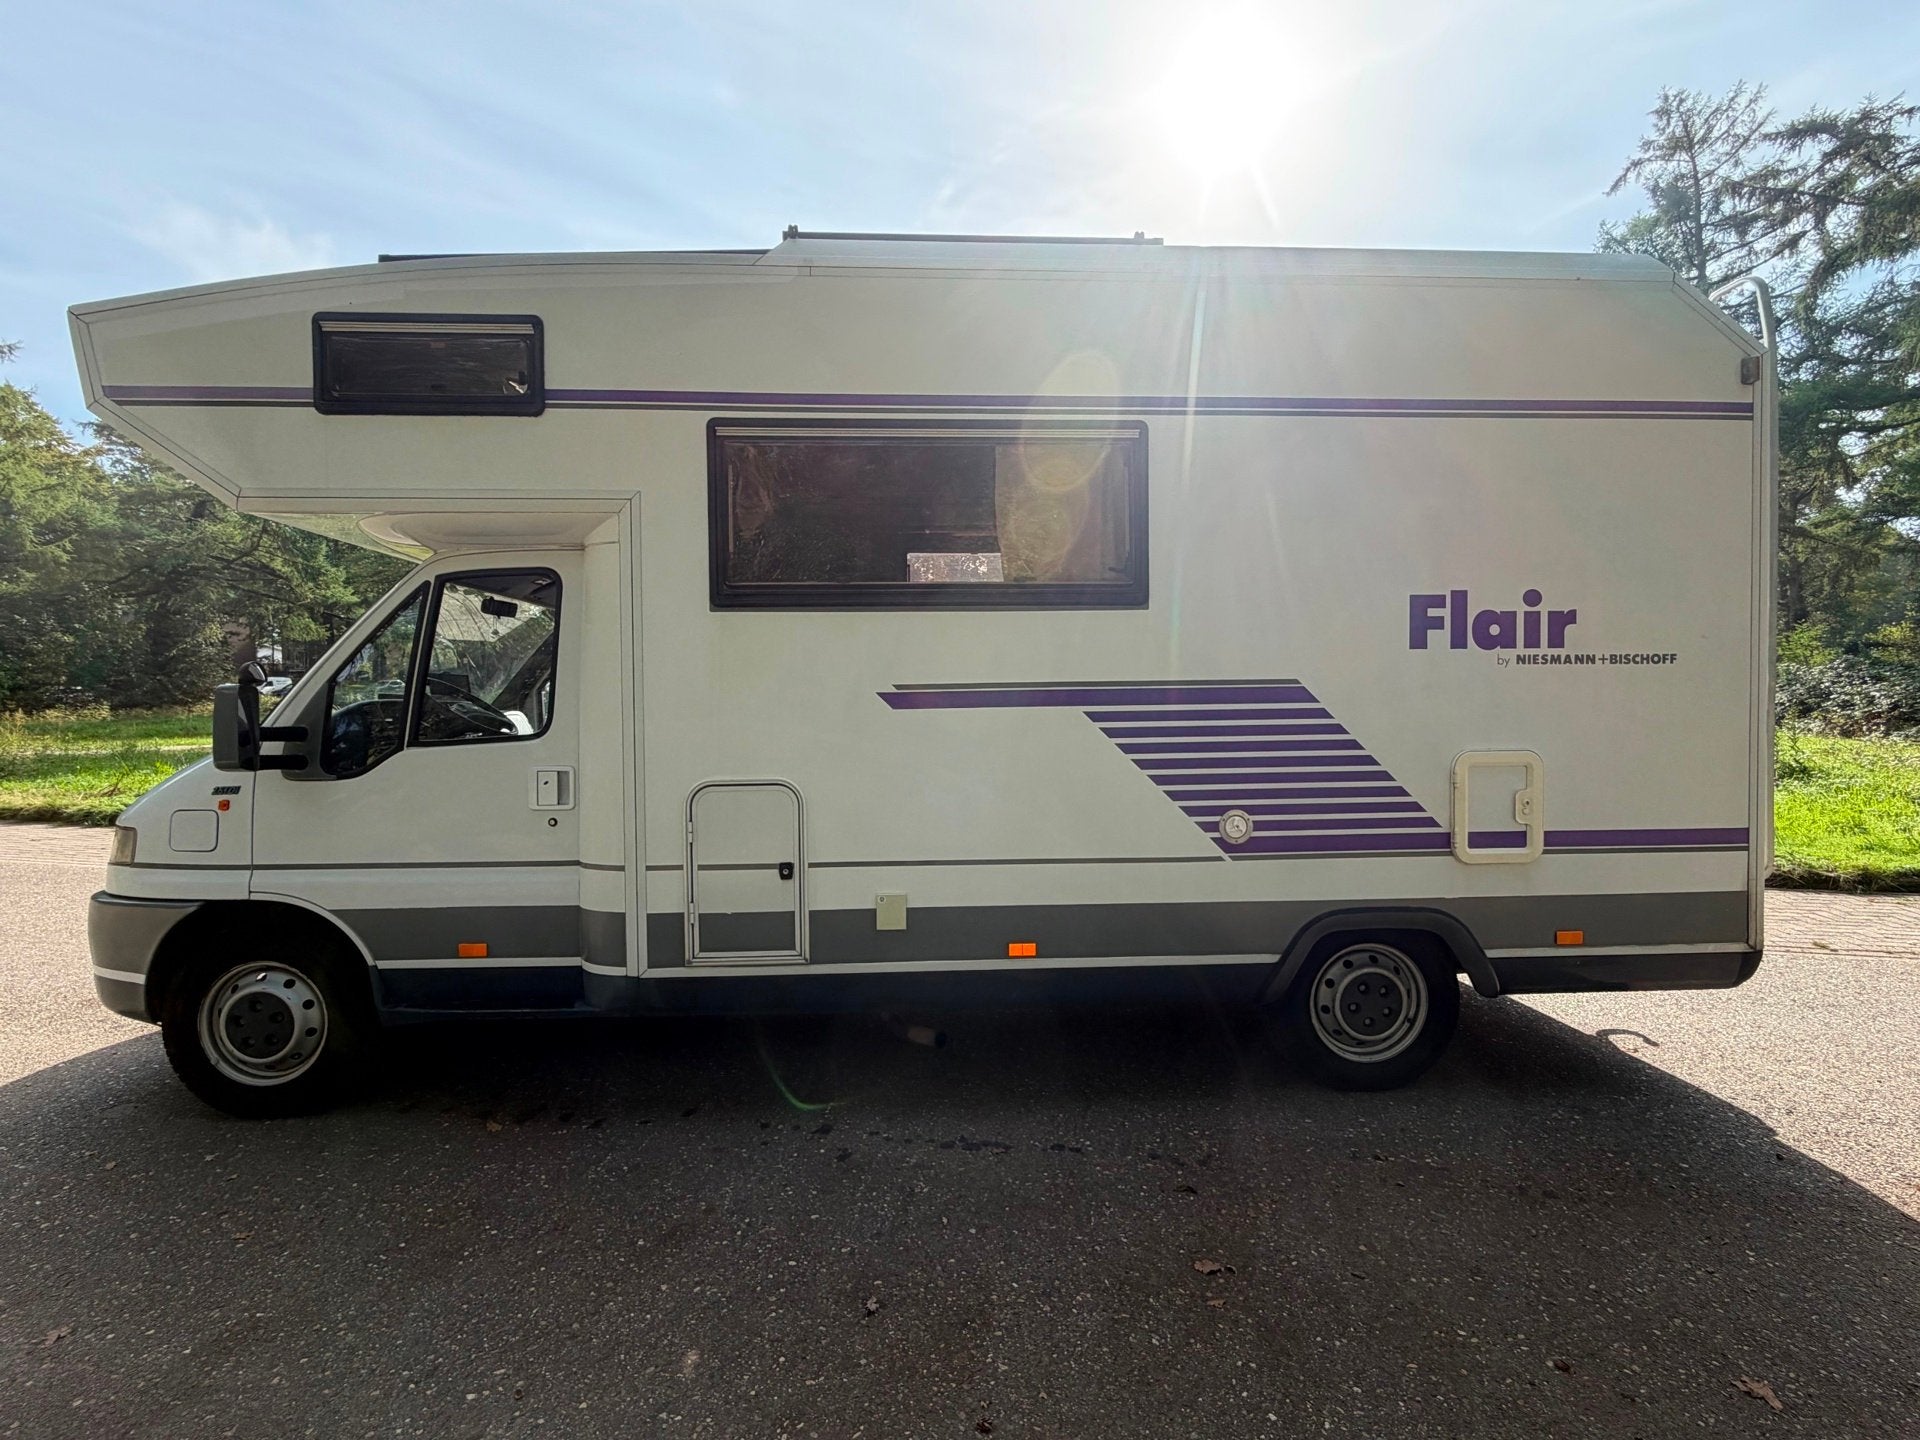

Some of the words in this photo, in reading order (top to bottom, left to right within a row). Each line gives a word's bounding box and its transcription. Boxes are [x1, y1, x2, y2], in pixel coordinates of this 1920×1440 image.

[1409, 589, 1577, 651] Flair
[1497, 653, 1511, 669] by
[1516, 653, 1678, 665] NIESMANN+BISCHOFF
